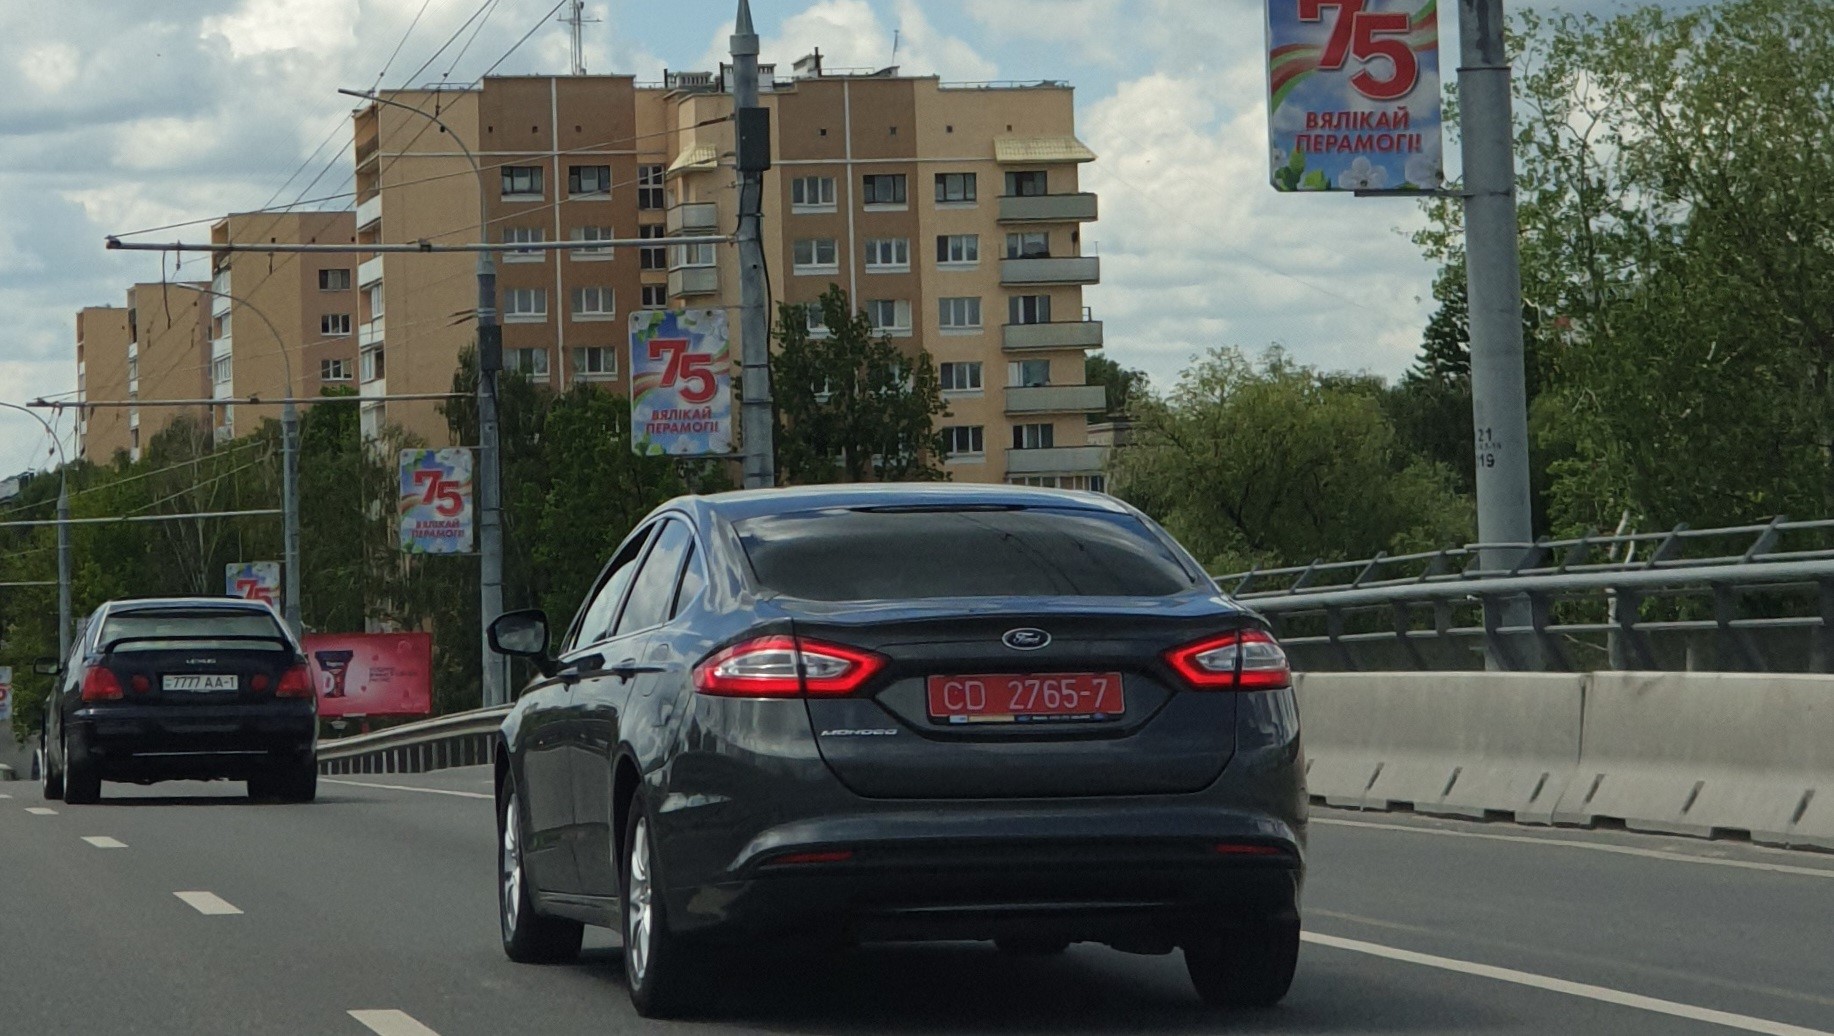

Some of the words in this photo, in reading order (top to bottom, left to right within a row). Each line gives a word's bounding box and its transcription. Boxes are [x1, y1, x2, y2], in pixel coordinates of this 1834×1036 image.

[1298, 0, 1418, 100] 75
[1305, 106, 1410, 131] ВЯЛІКАЙ
[1296, 133, 1422, 154] ПЕРАМОГІ!
[648, 338, 718, 403] 75
[651, 406, 712, 420] ВЯЛІКАЙ
[646, 421, 718, 433] ПЕРАМОГІ!
[413, 470, 463, 517] 75
[1014, 632, 1041, 644] Ford
[173, 677, 200, 688] 7777
[205, 677, 234, 688] AA-1
[943, 681, 986, 710] CD
[1008, 679, 1107, 710] 2765-7
[821, 728, 898, 736] MONDEO
